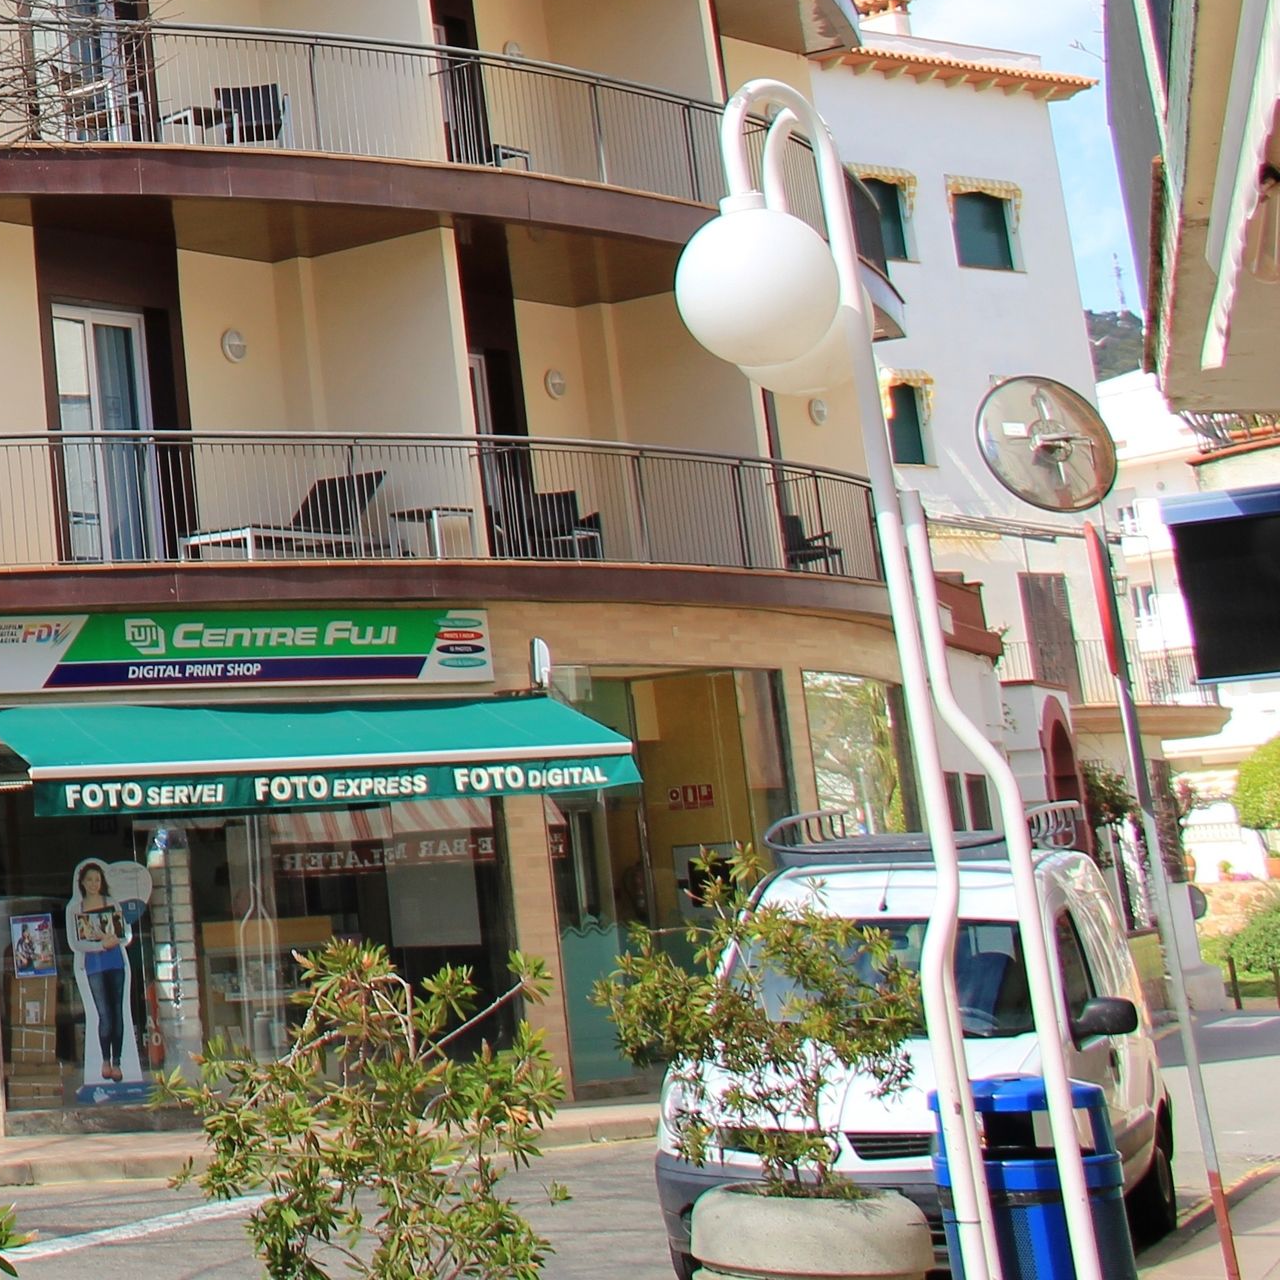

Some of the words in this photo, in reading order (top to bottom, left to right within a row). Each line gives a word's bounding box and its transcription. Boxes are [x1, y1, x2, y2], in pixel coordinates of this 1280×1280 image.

[172, 623, 318, 648] CENTRE
[128, 665, 182, 679] DIGITAL
[185, 664, 224, 677] PRINT
[226, 663, 261, 676] SHOP
[254, 775, 328, 801] FOTO
[333, 774, 428, 797] EXPRESS
[454, 766, 524, 791] FOTO
[528, 766, 608, 788] DIGITAL
[65, 782, 142, 808] FOTO
[147, 784, 224, 805] SERVEI
